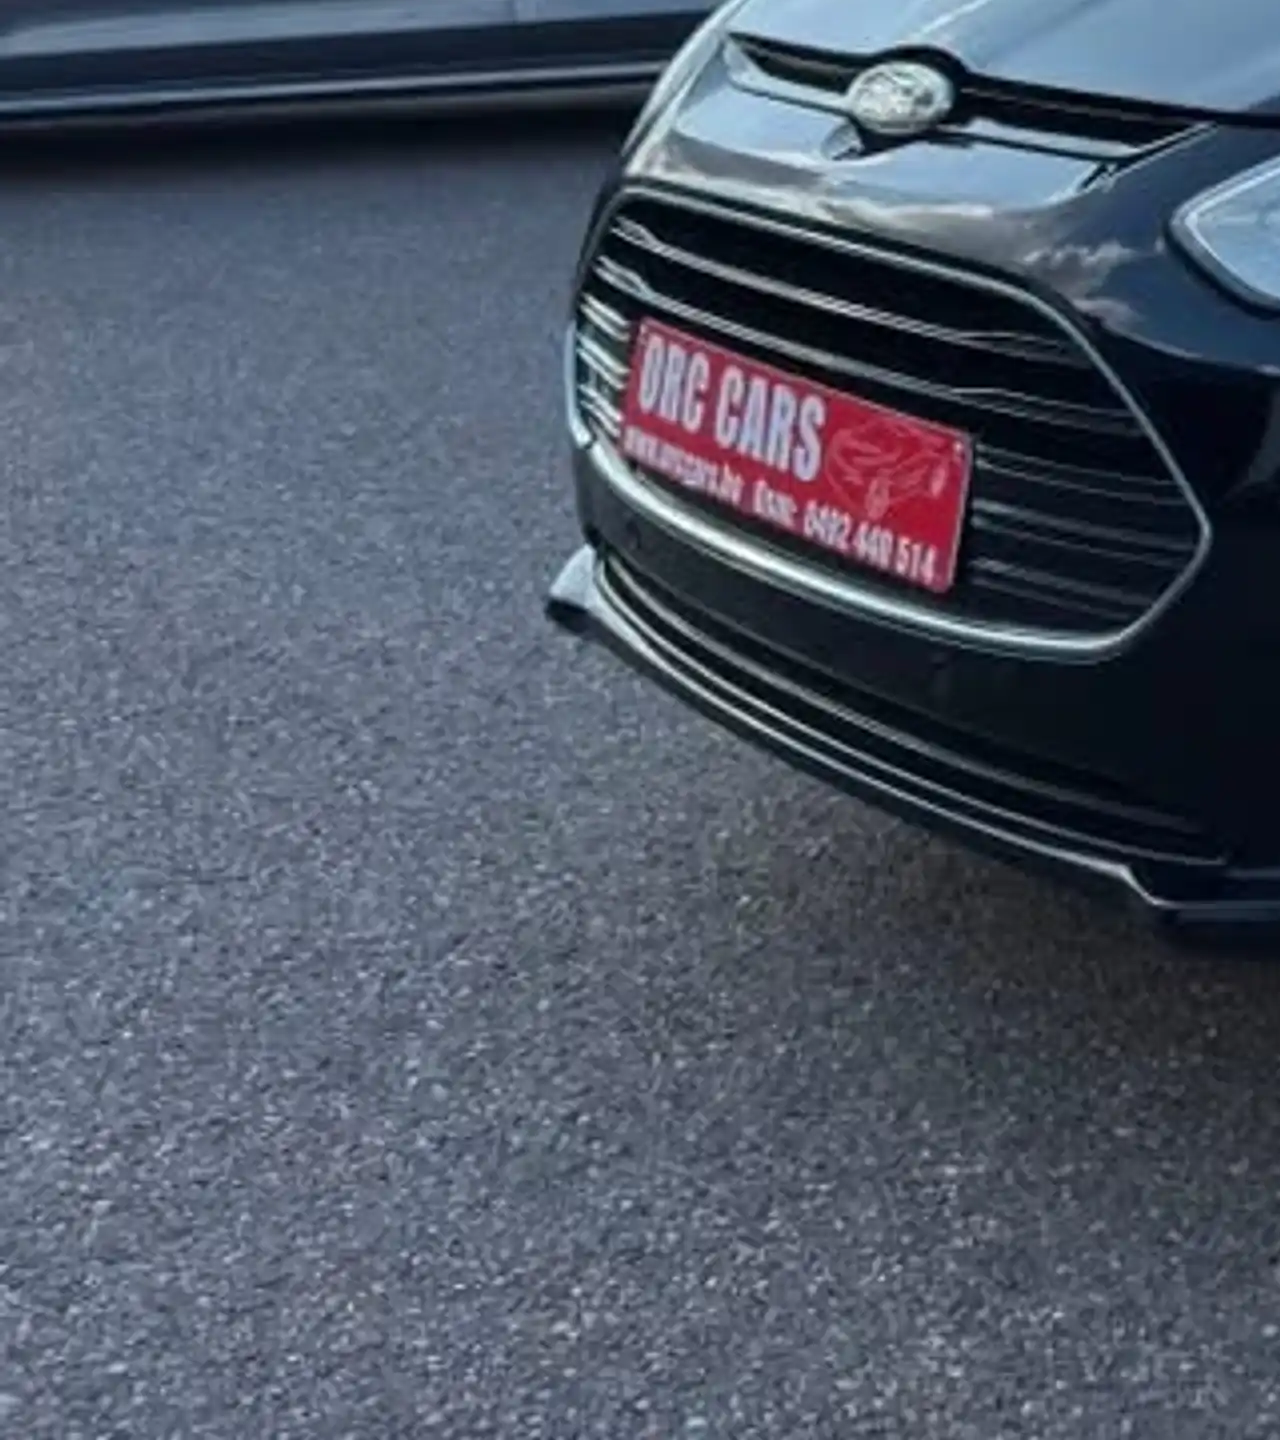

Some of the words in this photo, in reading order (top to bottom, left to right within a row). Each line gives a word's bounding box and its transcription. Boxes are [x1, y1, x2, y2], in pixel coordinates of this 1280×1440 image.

[638, 334, 710, 435] ORC
[714, 364, 826, 482] CARS
[896, 535, 937, 586] 514
